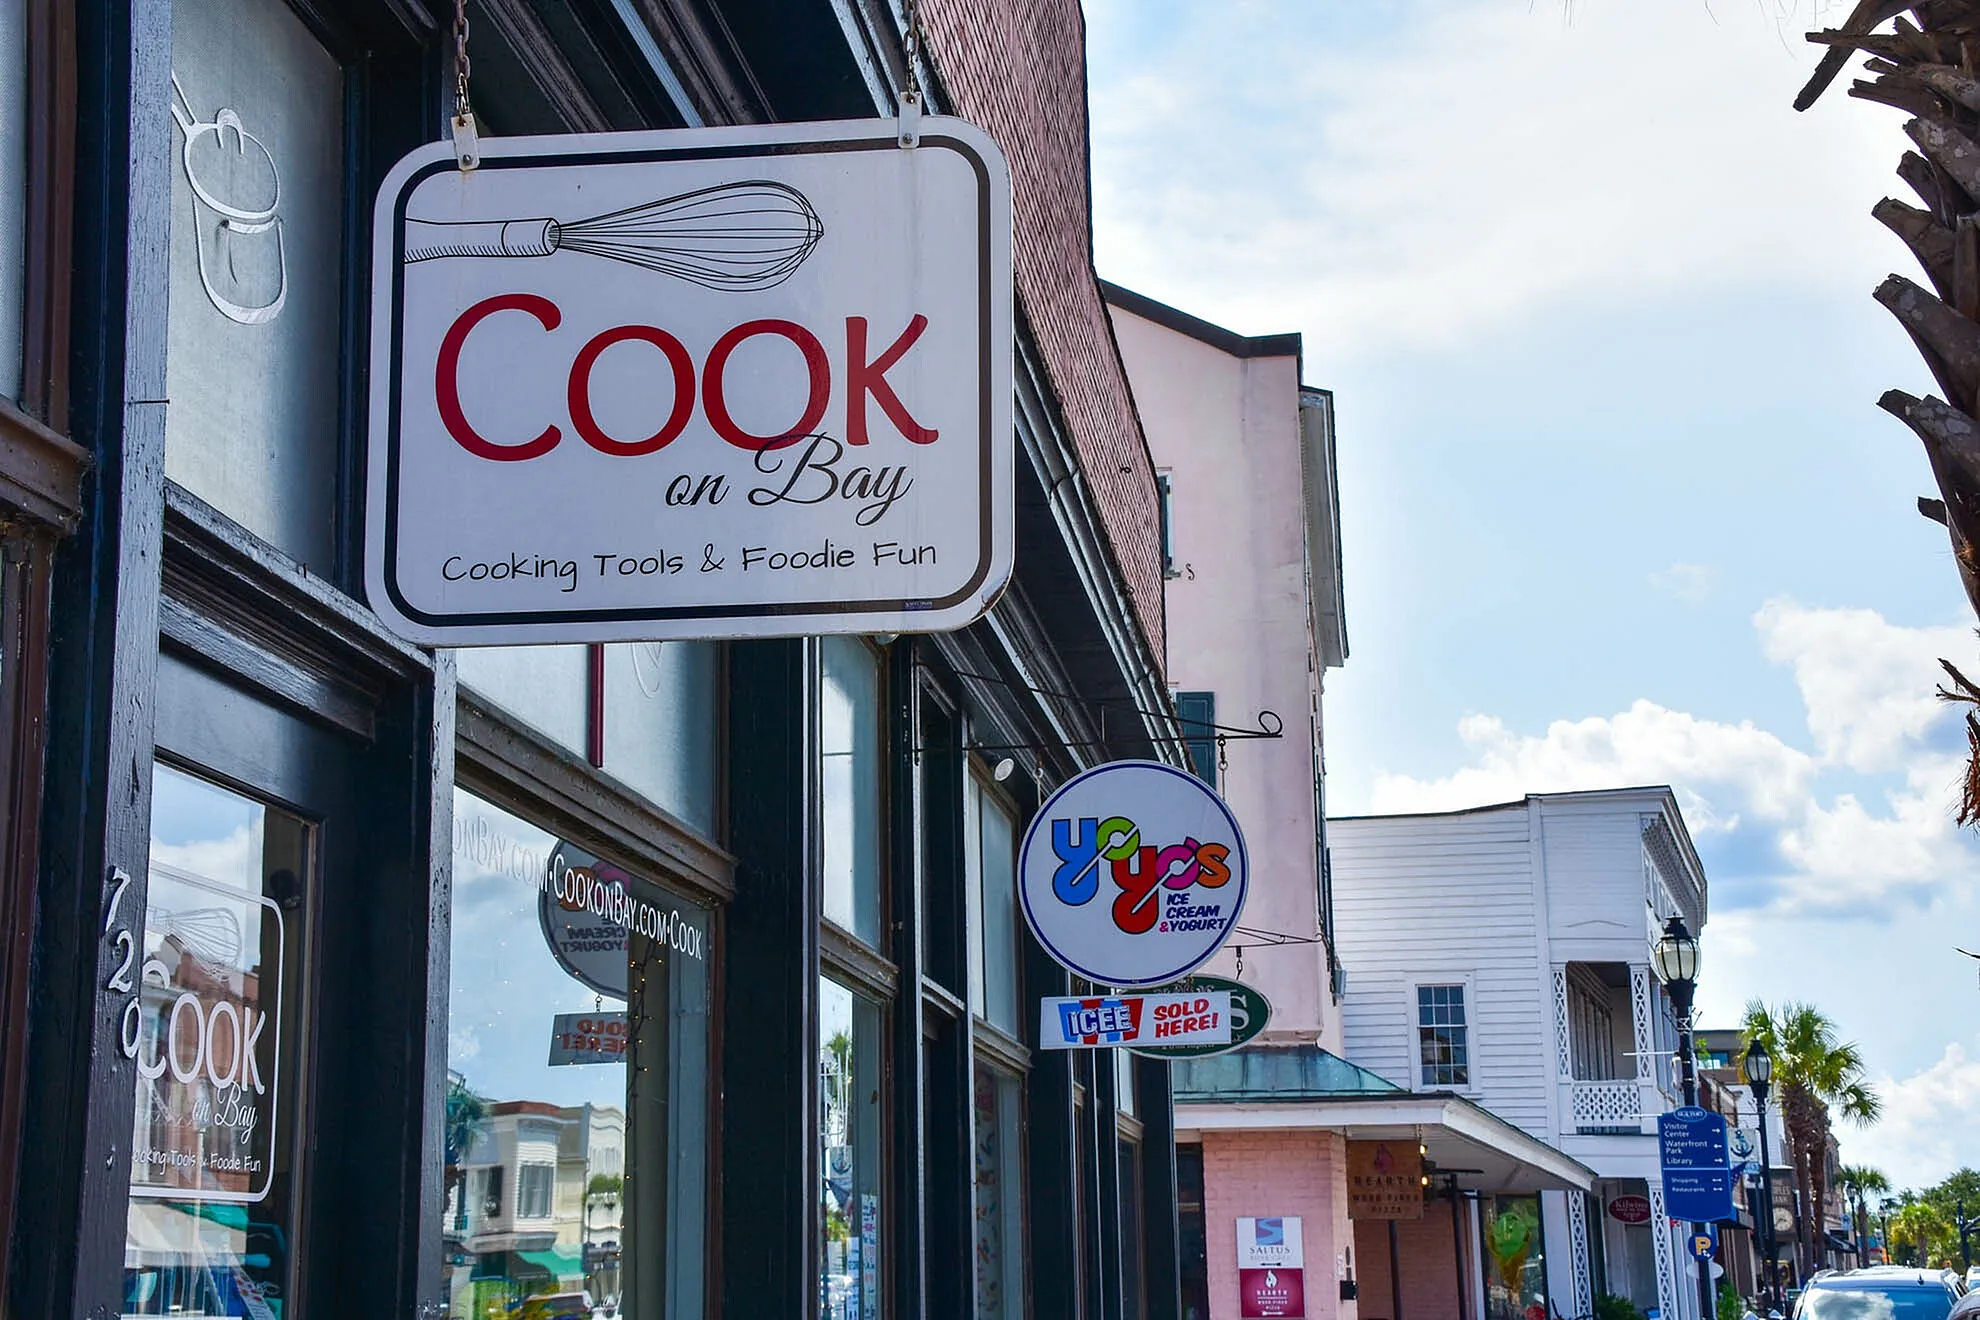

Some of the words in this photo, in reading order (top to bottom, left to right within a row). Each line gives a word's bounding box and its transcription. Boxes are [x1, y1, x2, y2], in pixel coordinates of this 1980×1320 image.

[665, 470, 728, 507] on
[748, 432, 914, 526] Bay
[442, 551, 578, 593] Cooking
[594, 549, 684, 577] Tools
[700, 544, 726, 573] &
[743, 539, 855, 573] Foodie
[874, 541, 937, 568] Fun
[1166, 893, 1190, 906] ICE
[1166, 905, 1221, 919] CREAM
[1154, 998, 1210, 1021] SOLD
[1069, 1007, 1132, 1037] ICEE
[1155, 1012, 1219, 1039] HERE!
[214, 1080, 257, 1144] Bay
[1664, 1130, 1689, 1138] Center
[1664, 1140, 1708, 1148] Waterfront
[243, 1154, 261, 1173] Fun
[1666, 1157, 1693, 1165] Library
[1695, 1236, 1711, 1255] P
